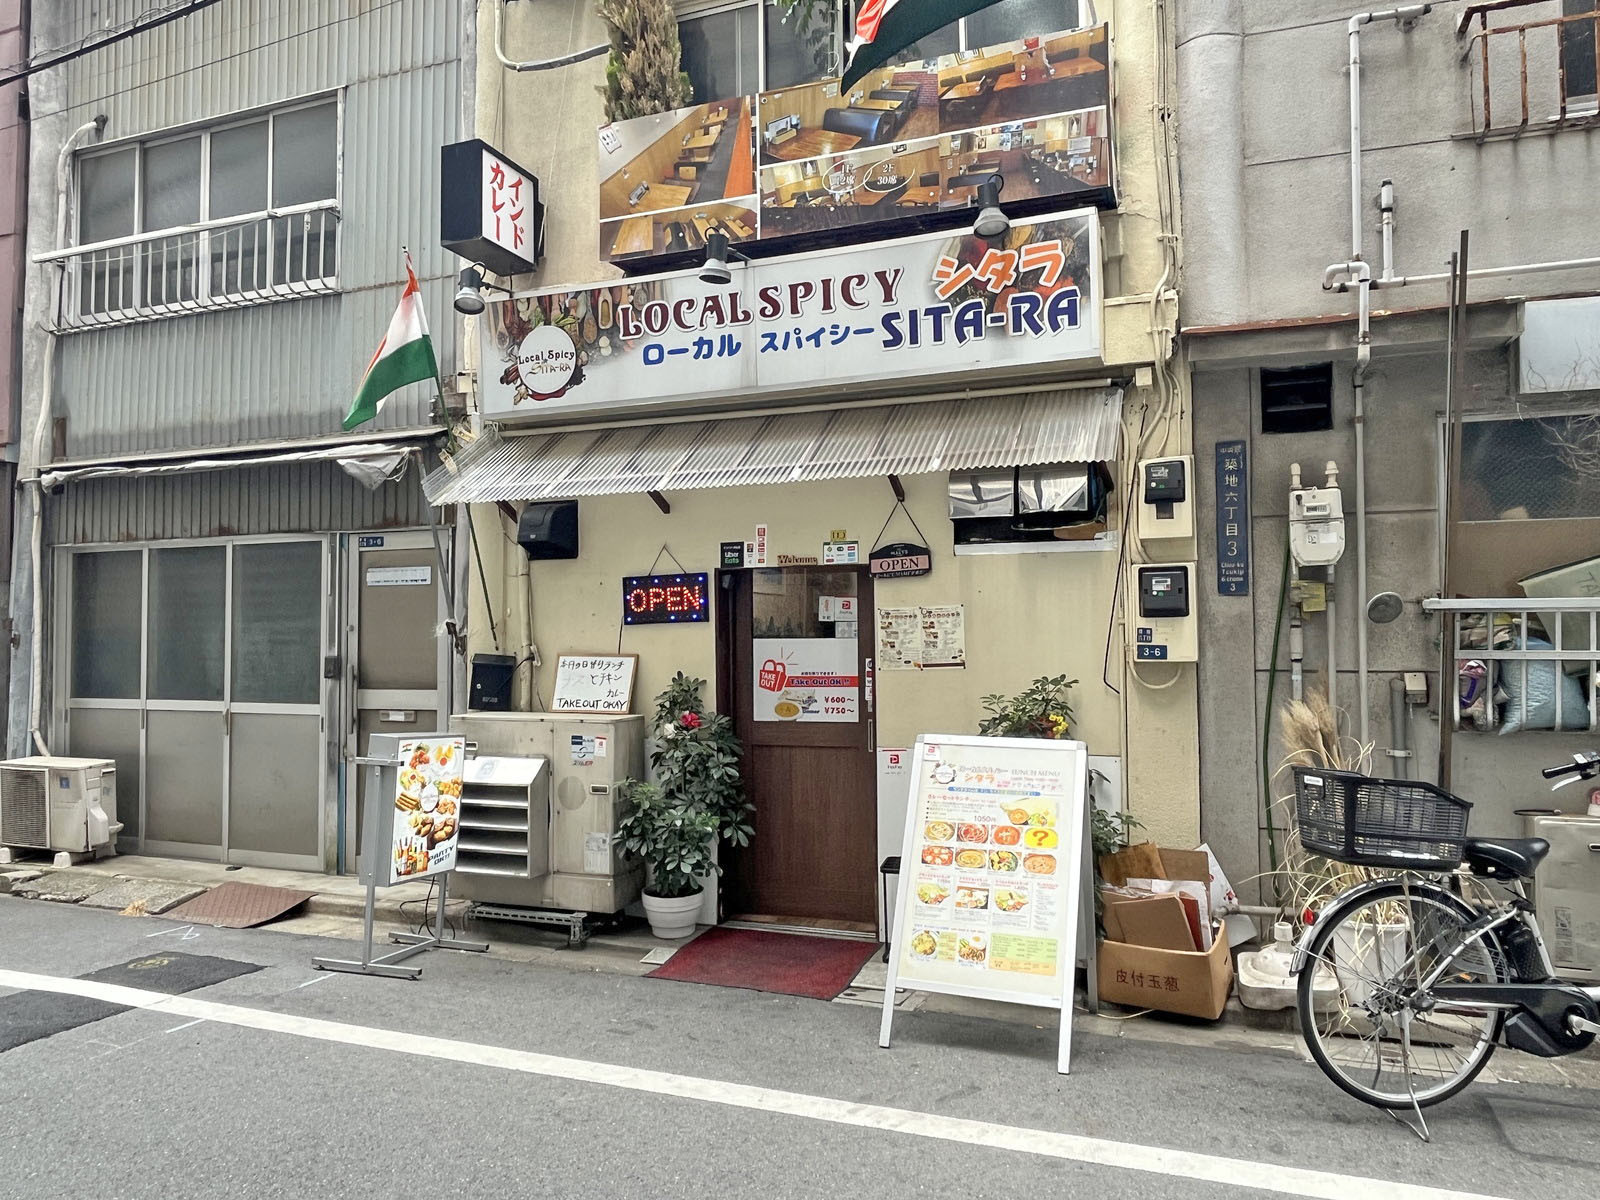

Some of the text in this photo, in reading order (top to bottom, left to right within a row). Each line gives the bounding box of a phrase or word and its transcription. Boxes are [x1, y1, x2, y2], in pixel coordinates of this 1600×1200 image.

[489, 160, 505, 242] カレー
[508, 176, 525, 250] インド
[935, 239, 1066, 300] シタラ
[619, 267, 902, 340] LOCAL SPICY
[881, 287, 1079, 350] SITA-RA
[643, 323, 876, 367] ローカル スパイシー
[517, 349, 576, 365] Local Spicy
[880, 557, 919, 571] OPEN
[1230, 583, 1236, 591] 3
[629, 585, 701, 613] OPEN
[1143, 647, 1161, 656] 3-6
[760, 680, 775, 688] OUT
[761, 672, 776, 680] TAKE
[606, 689, 625, 698] カレー
[602, 700, 628, 709] OKAY
[964, 774, 996, 783] シタラ
[1115, 968, 1180, 992] 皮付玉葱
